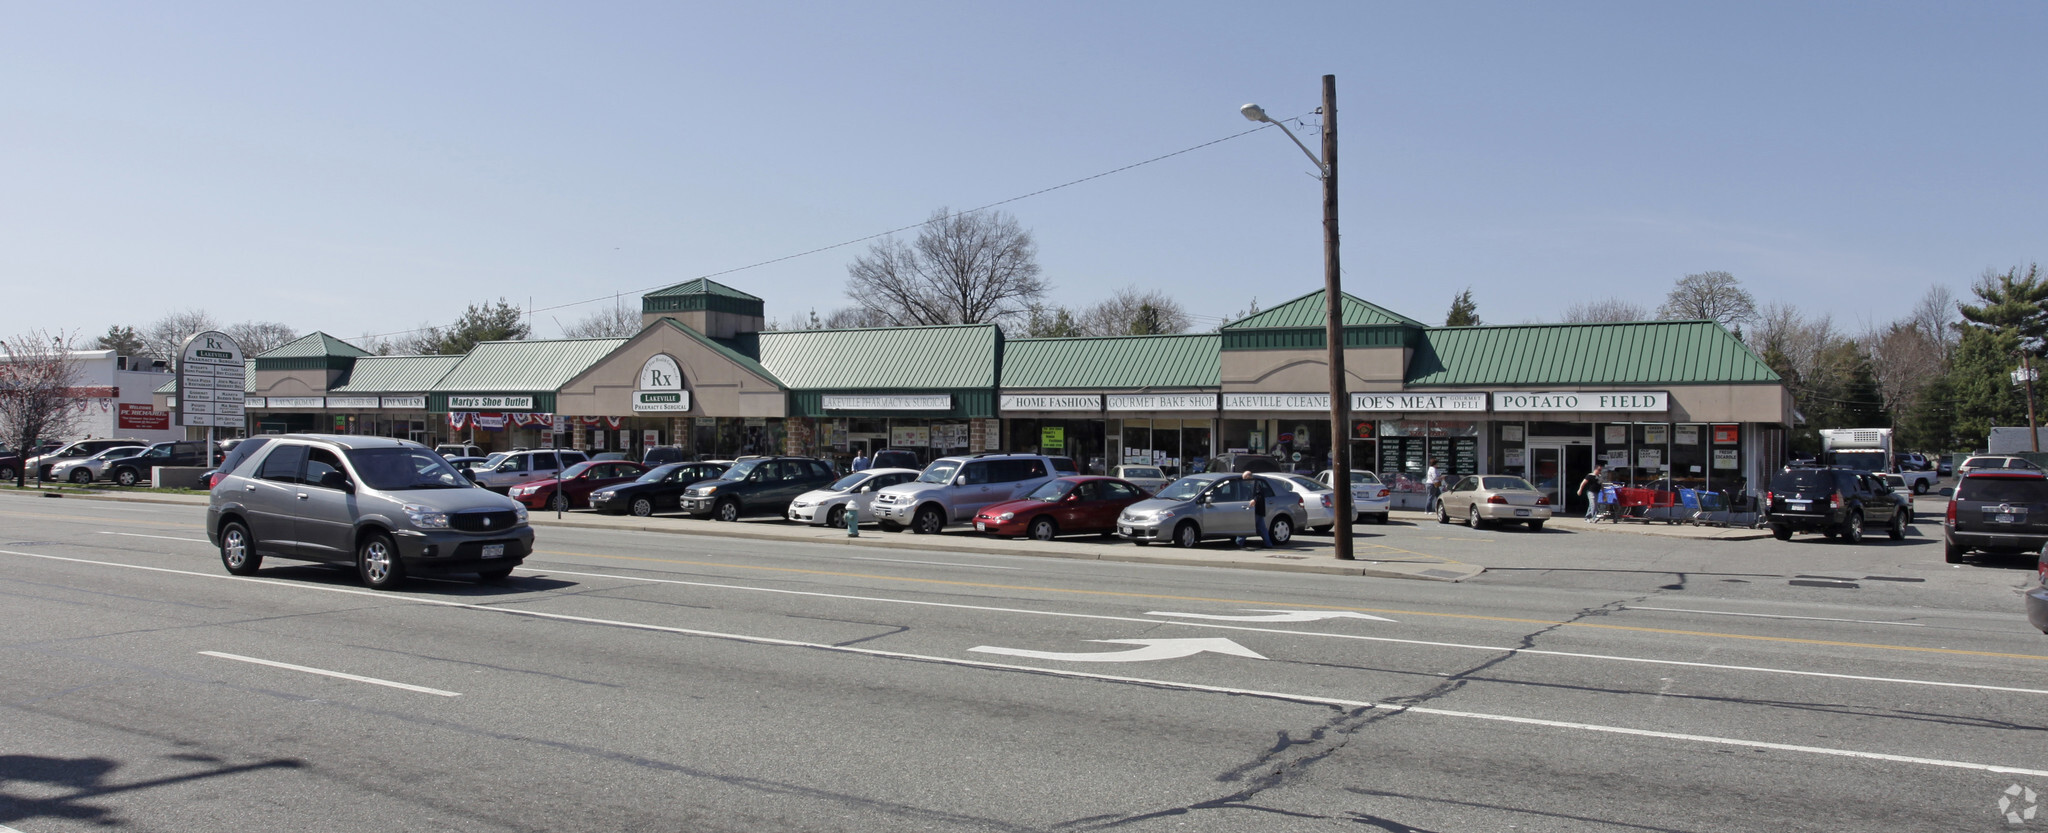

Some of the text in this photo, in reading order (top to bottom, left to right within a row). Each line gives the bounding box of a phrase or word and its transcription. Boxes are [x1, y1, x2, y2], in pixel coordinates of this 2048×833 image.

[206, 337, 223, 350] Rx
[200, 350, 229, 358] LAKEVILLE
[650, 369, 672, 387] Rx
[383, 396, 396, 407] FINE
[396, 396, 409, 407] NAIL
[413, 396, 424, 407] SPA
[451, 397, 529, 407] Marty's Shoe Outlet
[645, 394, 676, 402] LAKEVILLE
[823, 397, 950, 407] LAKEVILLE PHARMACY & SURGICAL
[1016, 397, 1047, 407] HOME
[1049, 397, 1100, 407] FASHIONS
[1108, 396, 1215, 408] GOURMET BAKE SHOP
[1225, 396, 1330, 407] LAKEVILLE CLEANE
[1356, 396, 1447, 409] JOE'S MEAT
[1503, 395, 1656, 408] POTATO FIELD
[1453, 401, 1479, 409] DELI
